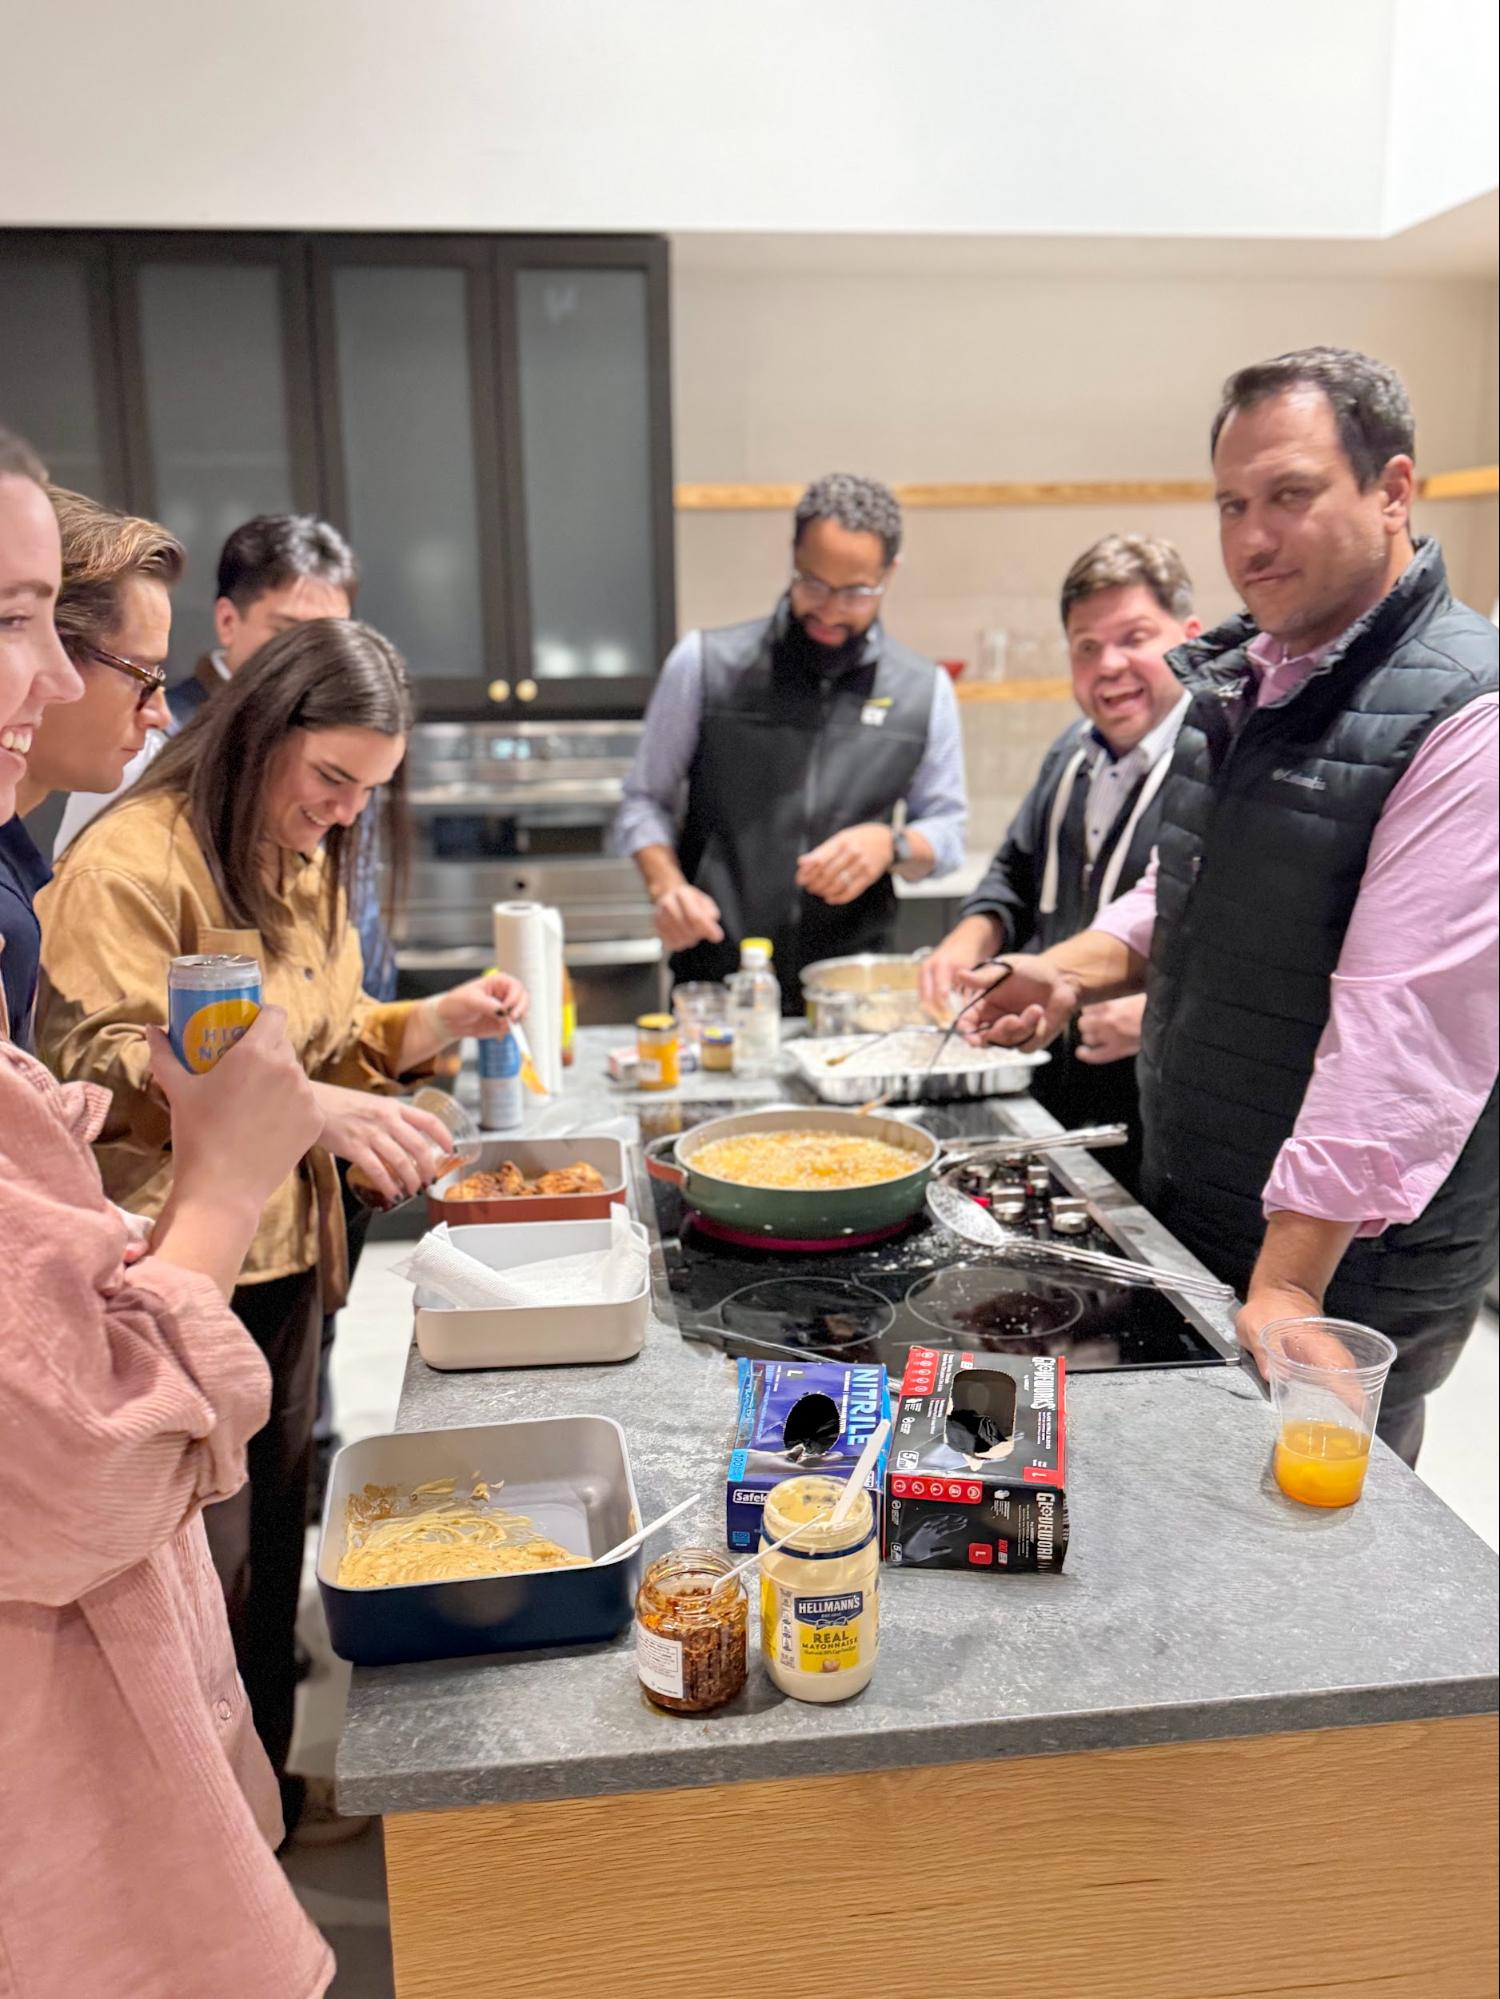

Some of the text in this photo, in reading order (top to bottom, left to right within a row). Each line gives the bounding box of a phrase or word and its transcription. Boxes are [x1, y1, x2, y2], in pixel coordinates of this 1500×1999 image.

[204, 1026, 247, 1041] HIG
[847, 1368, 880, 1446] NITRILE
[736, 1492, 768, 1502] Safek
[798, 1595, 861, 1614] HELLMANN'S
[802, 1637, 858, 1650] MAYONNAISE
[813, 1631, 849, 1644] REAL
